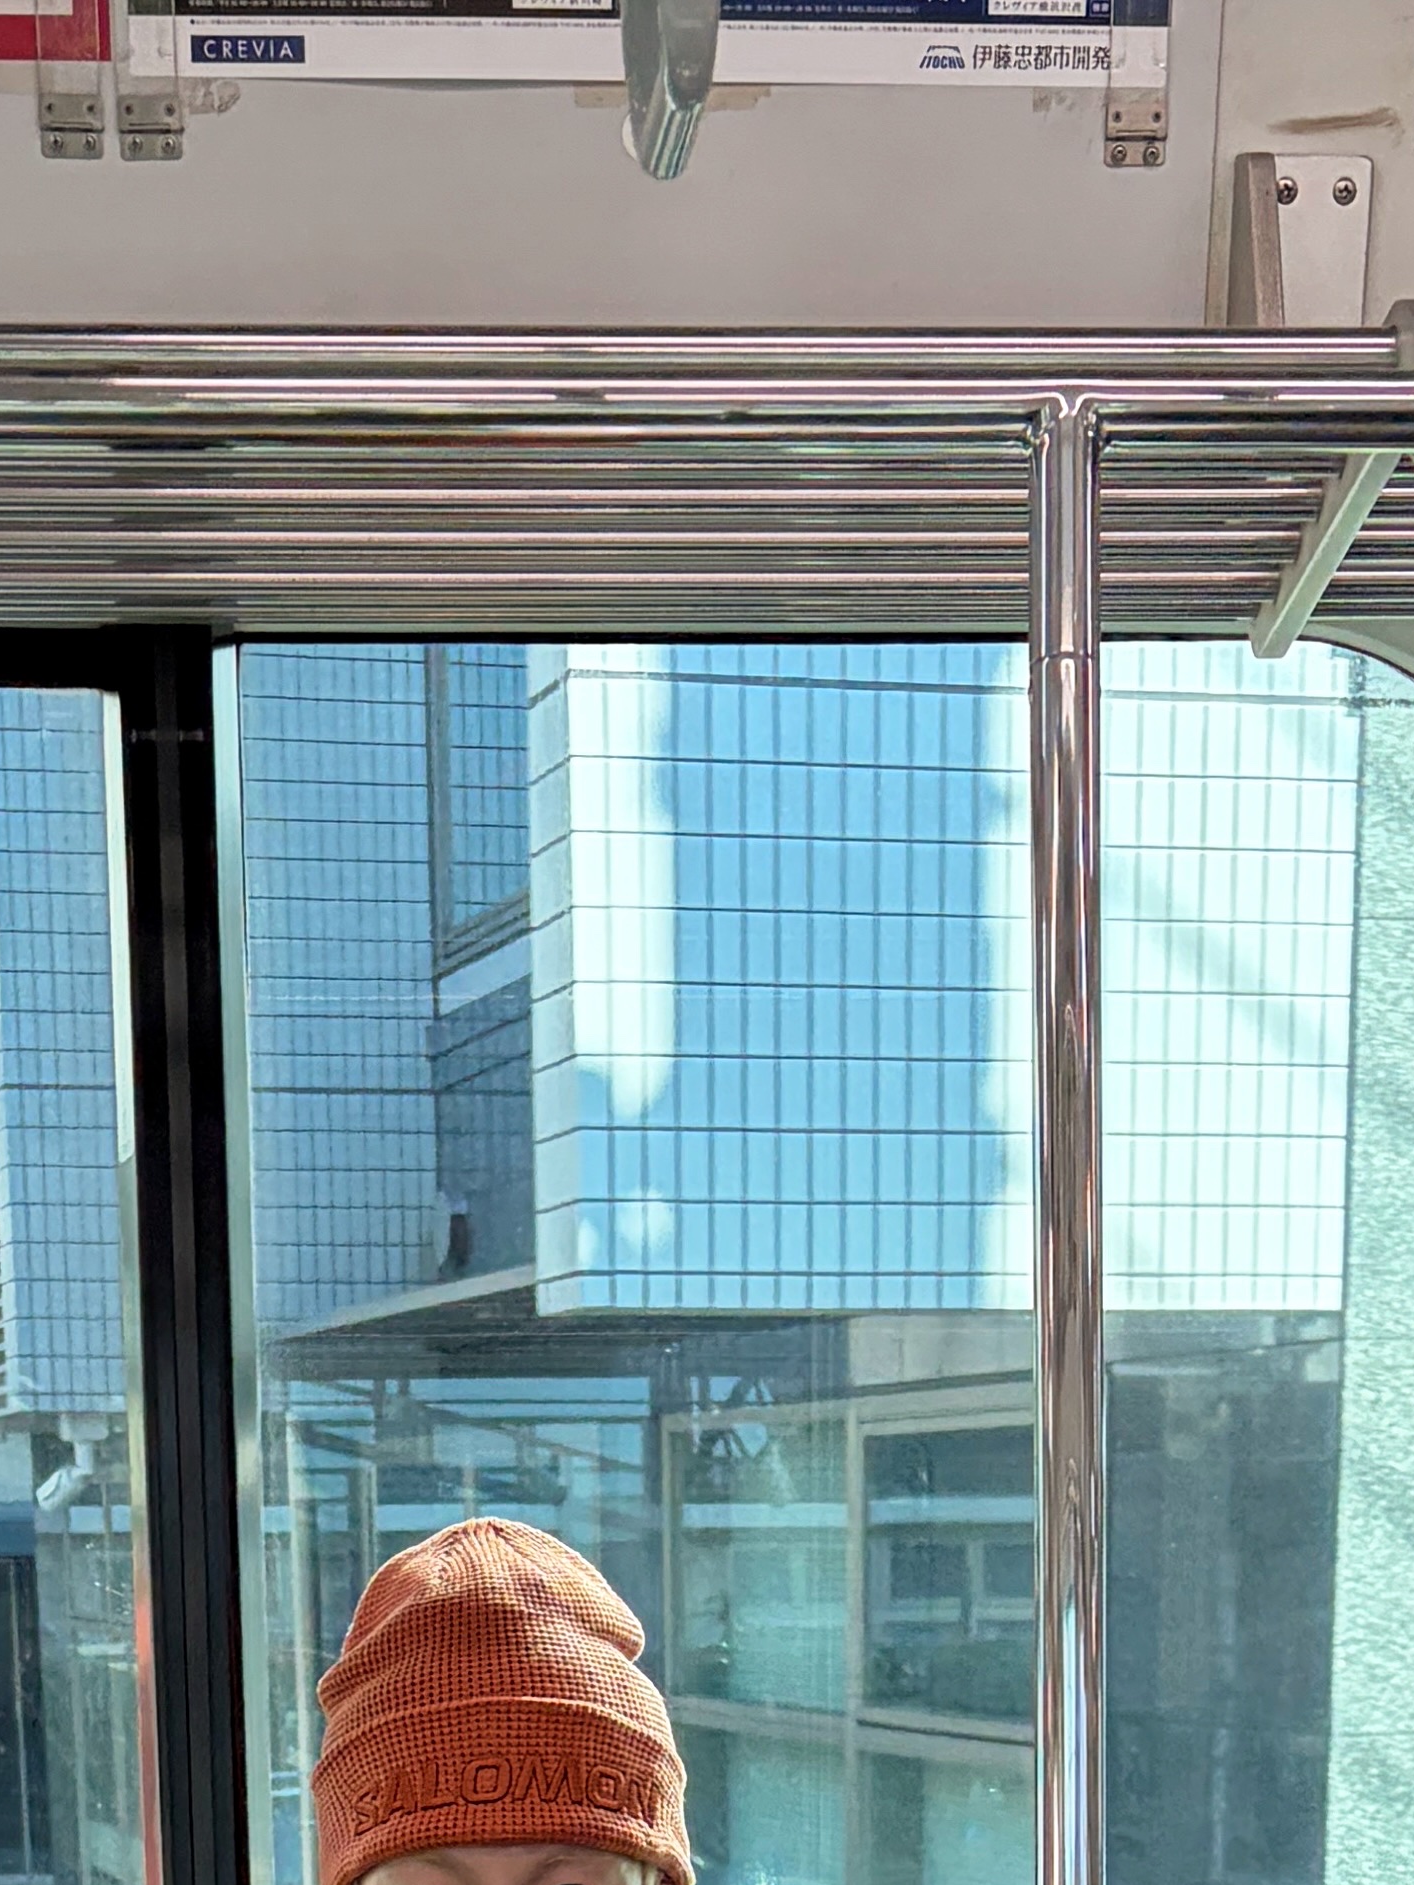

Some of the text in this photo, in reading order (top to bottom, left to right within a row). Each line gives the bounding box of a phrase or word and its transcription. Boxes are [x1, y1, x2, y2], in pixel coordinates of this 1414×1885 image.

[203, 39, 295, 60] CREVIA
[972, 43, 1111, 71] 伊藤忠都市開発
[353, 1752, 661, 1837] SALOMON
